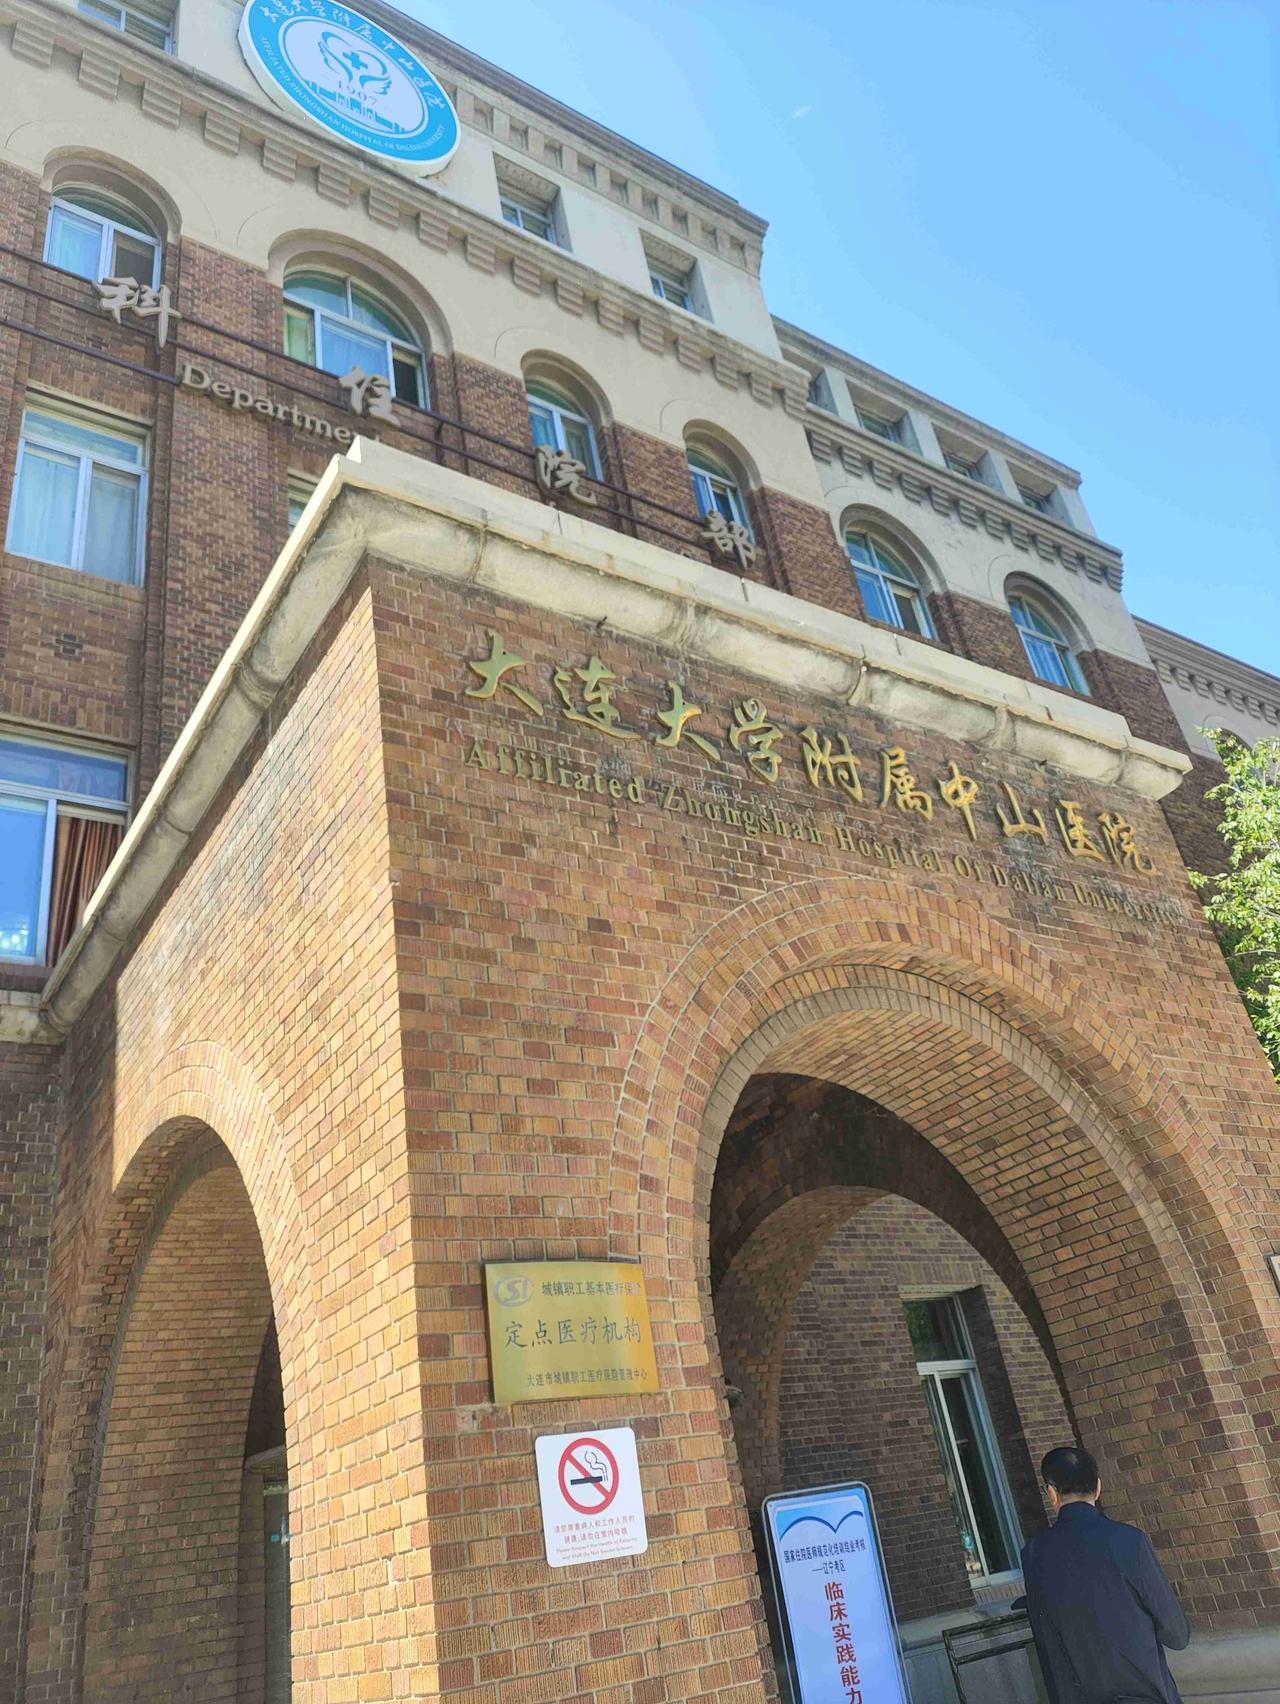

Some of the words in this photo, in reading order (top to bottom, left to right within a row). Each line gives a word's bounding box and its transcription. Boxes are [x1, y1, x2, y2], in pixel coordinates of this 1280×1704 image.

[465, 628, 1159, 877] 大连大学附属中山医院
[465, 740, 646, 805] Affiliated
[660, 783, 823, 845] Zhongshan
[834, 826, 943, 873] Hospital
[953, 853, 983, 882] Of
[990, 862, 1065, 901] Dalian
[504, 1315, 642, 1349] 定点医疗机构
[824, 1580, 863, 1704] 临床实践能力
